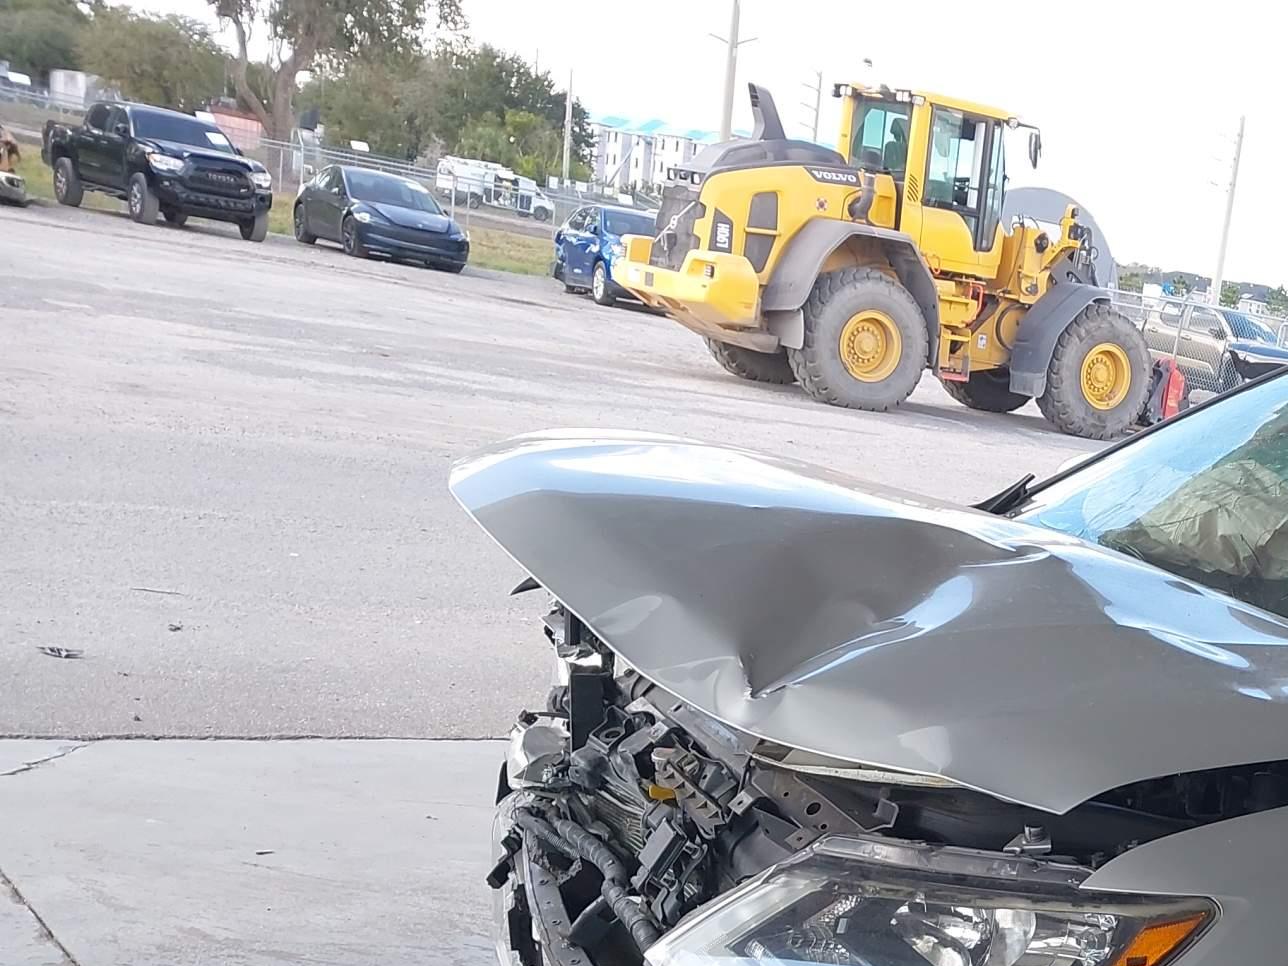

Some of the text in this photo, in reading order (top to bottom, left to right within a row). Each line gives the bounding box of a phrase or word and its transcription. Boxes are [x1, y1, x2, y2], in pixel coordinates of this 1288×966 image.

[208, 172, 234, 183] TOYOTA
[811, 170, 857, 183] VOLVO
[716, 223, 730, 248] L90H
